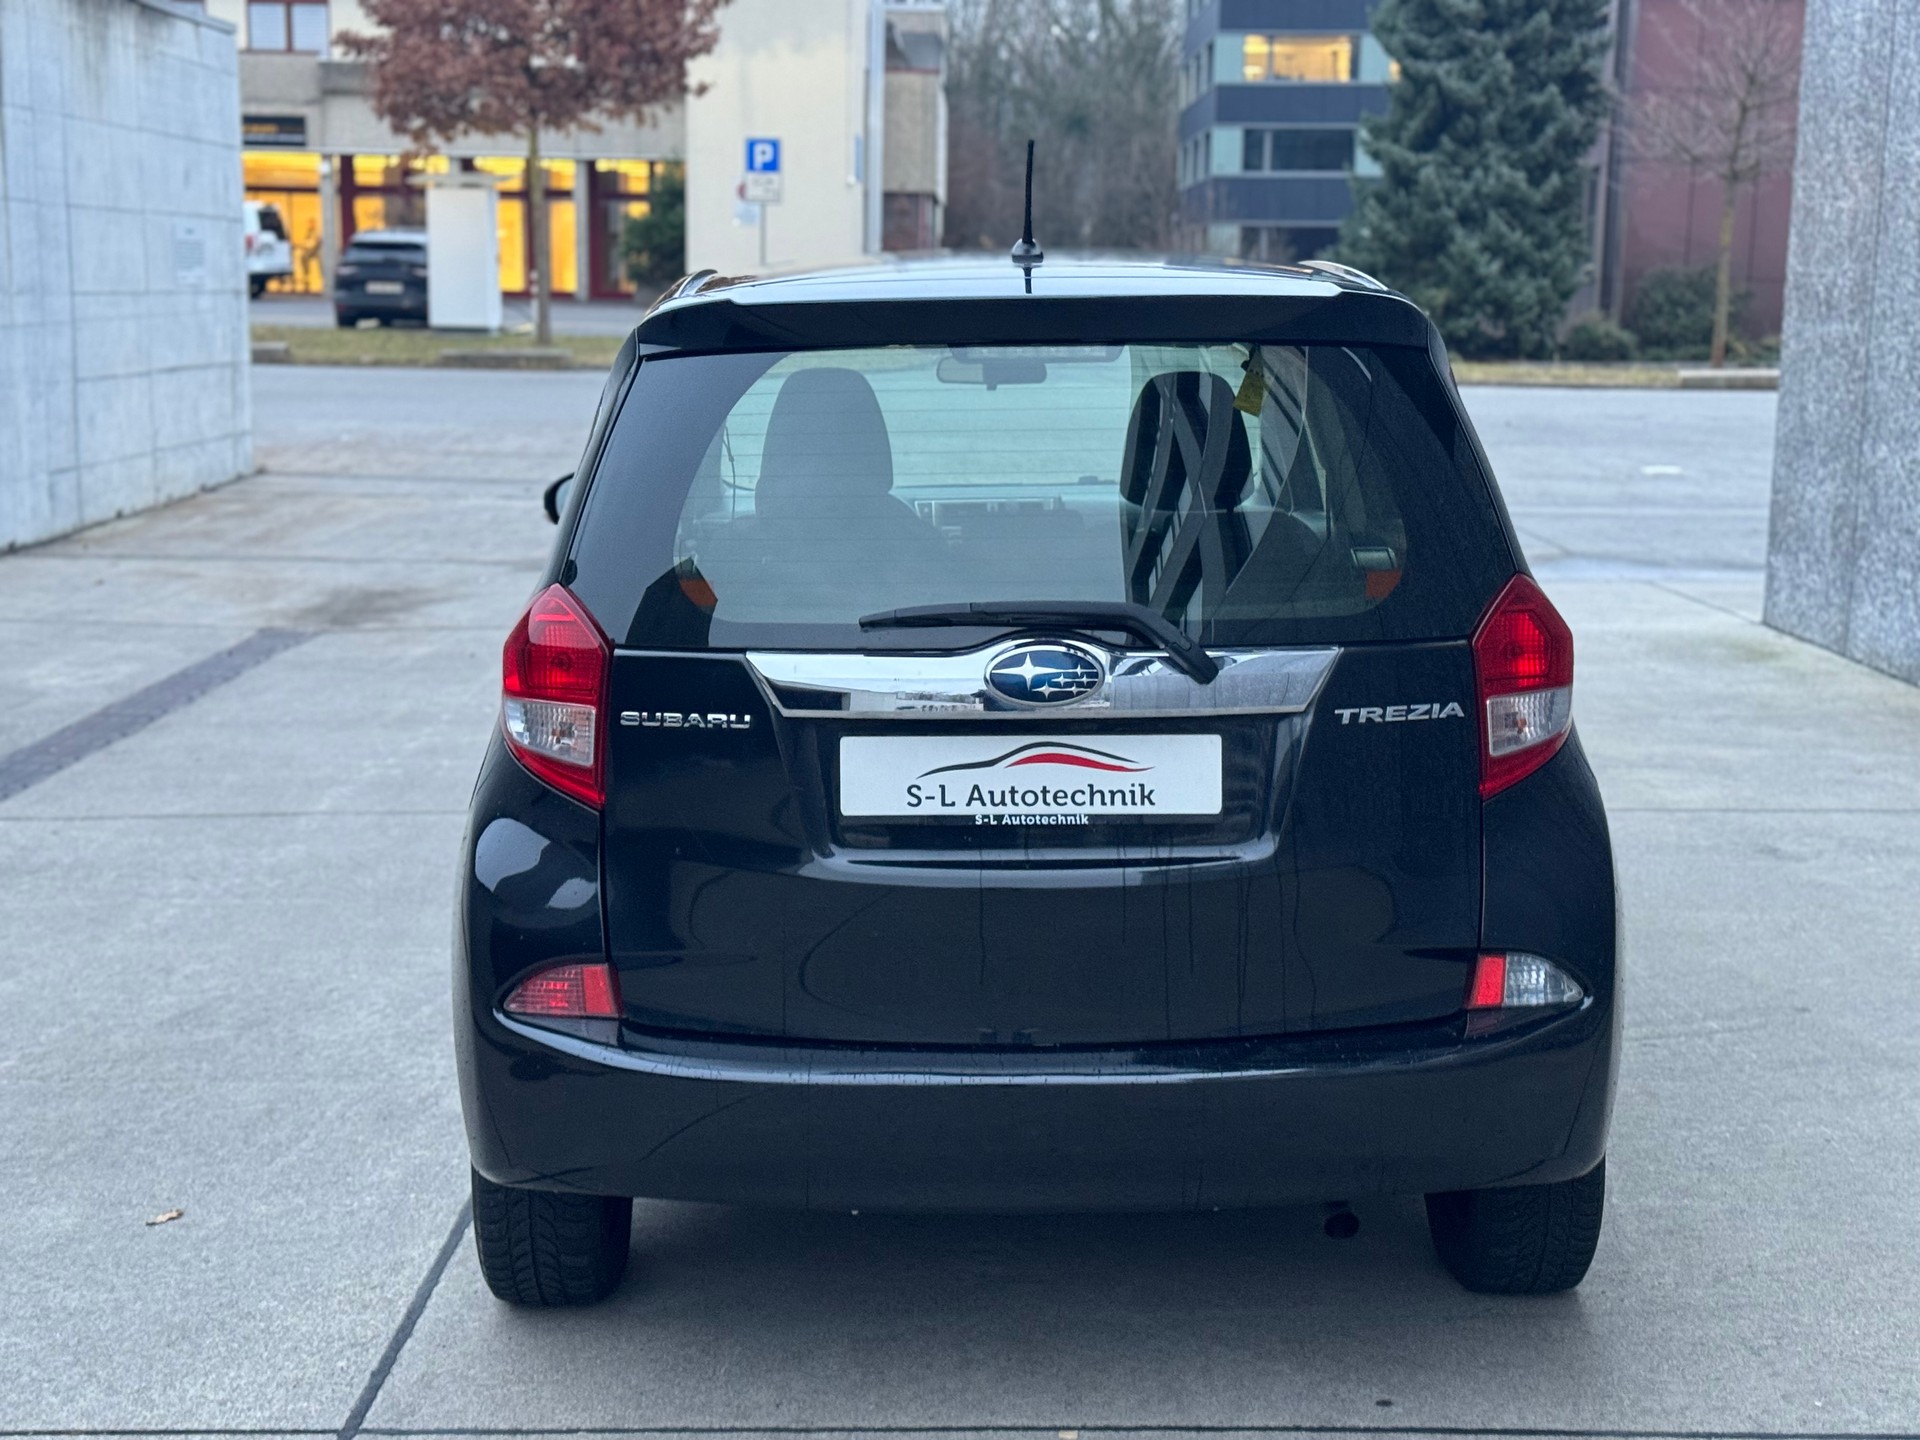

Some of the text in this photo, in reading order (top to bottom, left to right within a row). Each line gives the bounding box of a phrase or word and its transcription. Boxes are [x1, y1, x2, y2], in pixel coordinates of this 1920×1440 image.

[752, 143, 775, 171] P
[620, 711, 751, 729] SUBARU
[1334, 702, 1465, 725] TREZIA
[906, 783, 1156, 807] S-L Autotechnik
[975, 814, 1089, 826] S-L Autotechnik
